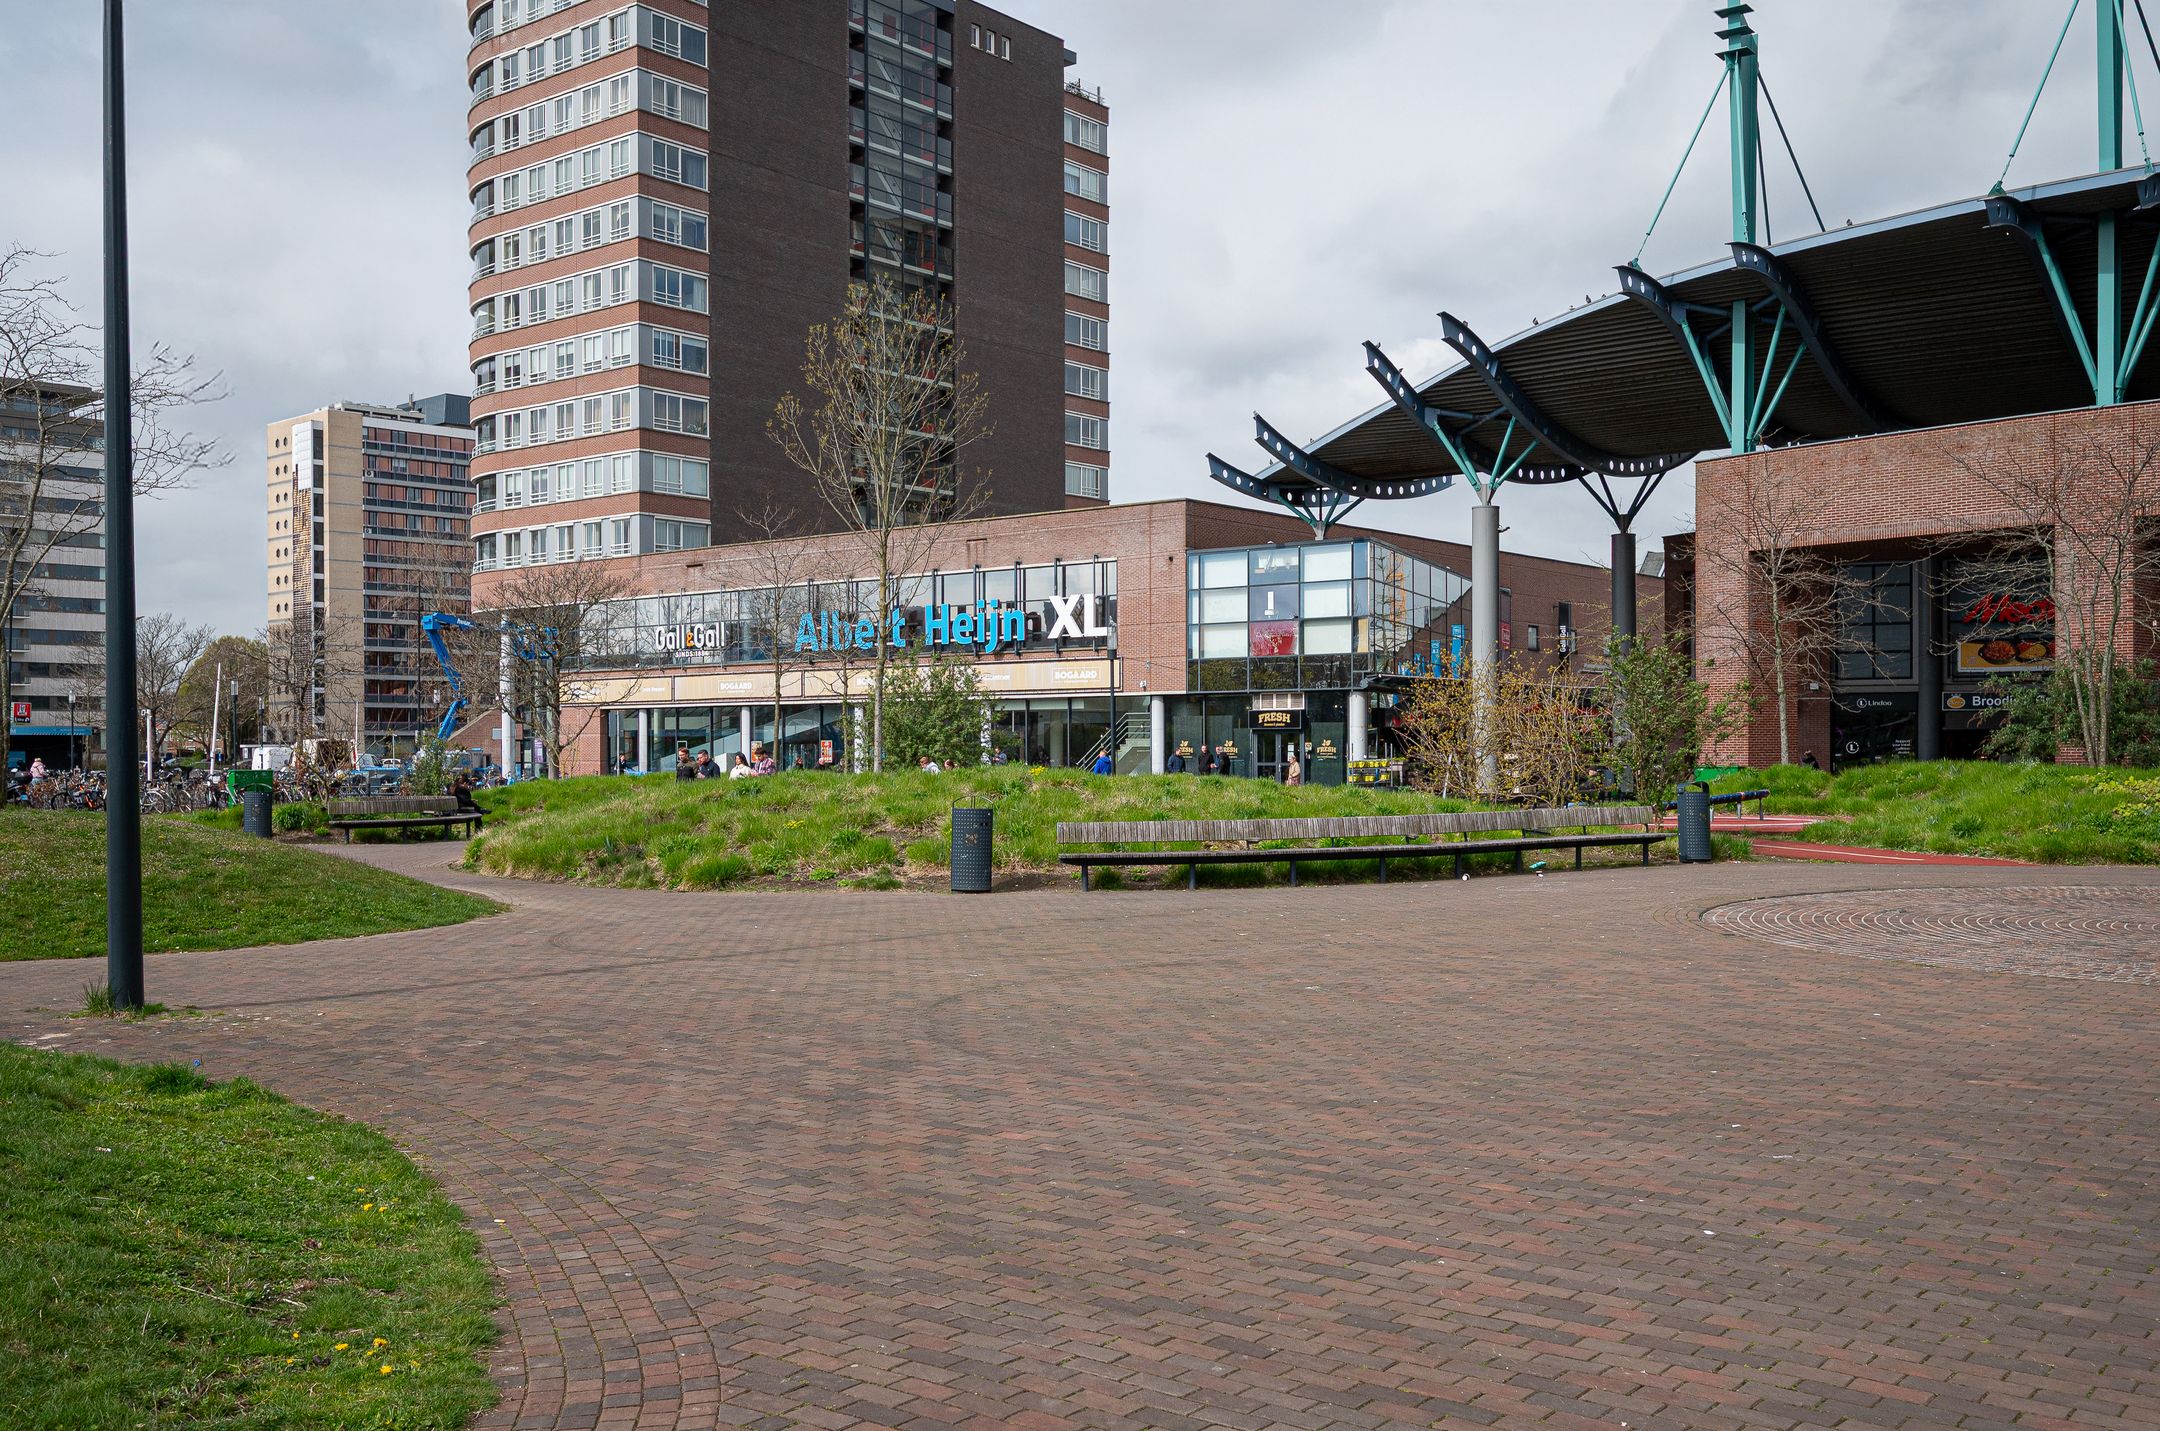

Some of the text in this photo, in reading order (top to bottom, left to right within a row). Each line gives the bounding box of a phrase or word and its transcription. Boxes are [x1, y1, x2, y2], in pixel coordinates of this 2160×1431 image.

[924, 598, 1026, 653] Heijn
[1048, 593, 1108, 639] XL
[1054, 670, 1098, 680] BOGAARD
[720, 682, 752, 690] BOGAARD
[1258, 711, 1291, 724] FRESH
